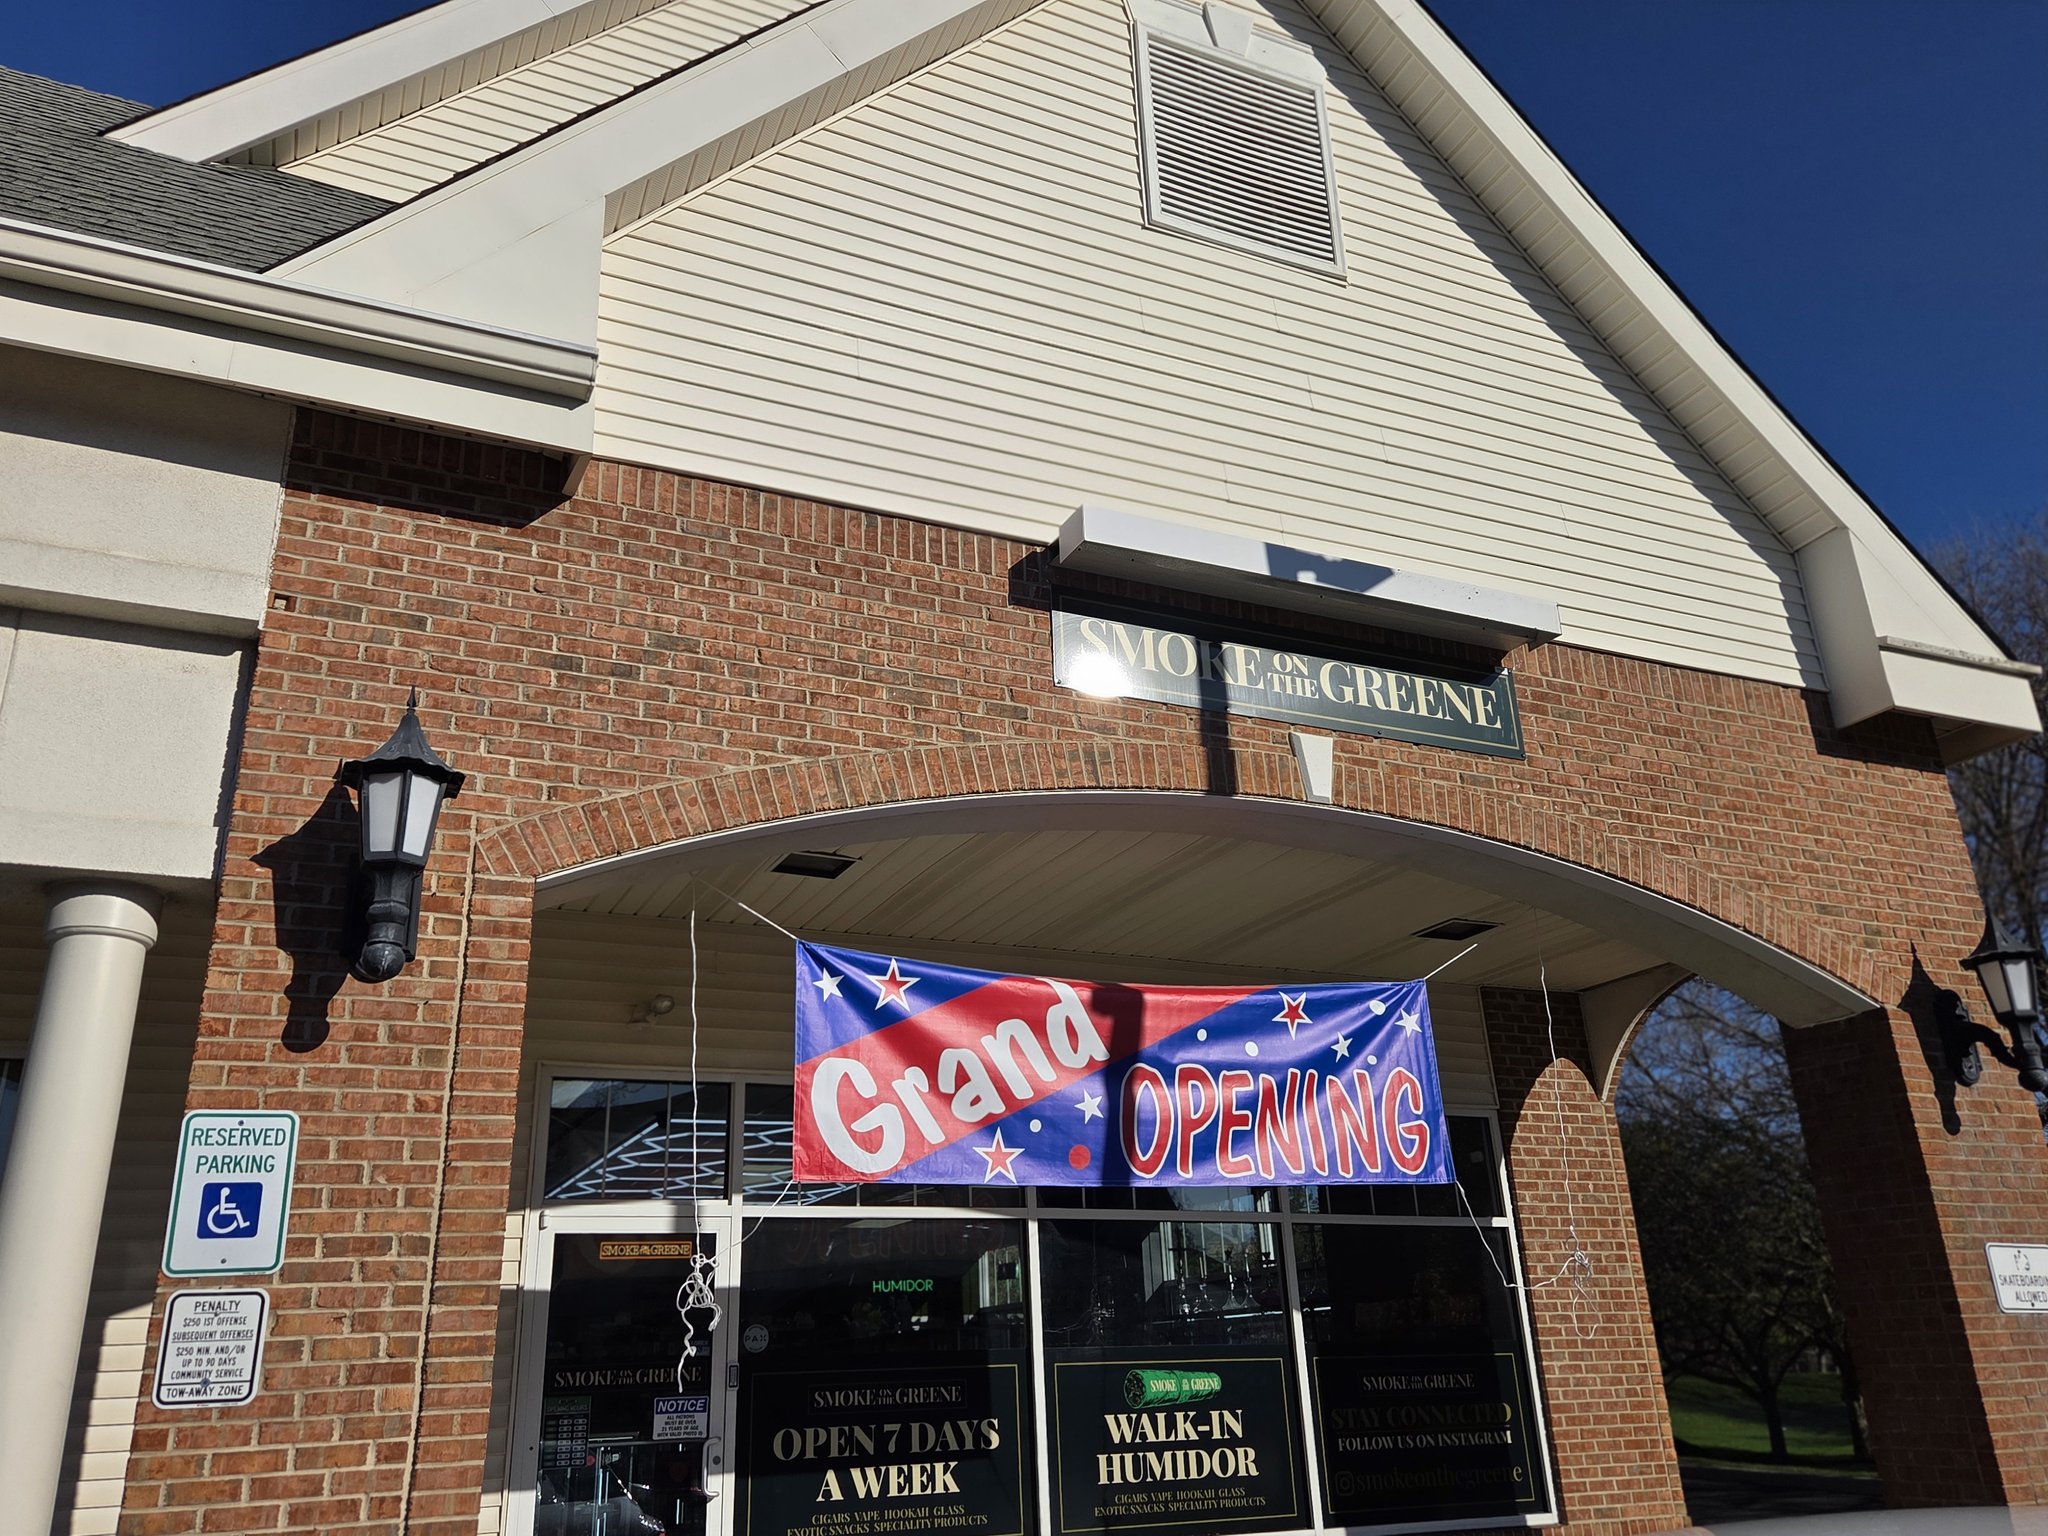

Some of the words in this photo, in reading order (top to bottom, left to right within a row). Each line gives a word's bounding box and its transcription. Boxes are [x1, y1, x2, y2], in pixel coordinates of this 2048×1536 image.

[1079, 616, 1265, 690] SMOKE
[1273, 652, 1310, 677] ON
[1267, 671, 1319, 700] THE
[1319, 659, 1502, 730] GREENE
[810, 977, 1110, 1175] Grand
[1118, 1063, 1432, 1179] OPENING
[191, 1127, 287, 1147] RESERVED
[195, 1154, 276, 1174] PARKING
[602, 1244, 640, 1256] SMOKE
[650, 1244, 690, 1255] GREENE
[872, 1279, 934, 1293] HUMIDOR
[194, 1300, 241, 1312] PENALTY
[2015, 1290, 2048, 1303] ALLOWED
[183, 1317, 201, 1328] $250
[216, 1316, 247, 1326] OFFENSE
[172, 1330, 217, 1341] SUBSEQUENT
[220, 1329, 254, 1339] OFFENSES
[176, 1346, 194, 1357] $250
[215, 1344, 246, 1357] AND/OR
[181, 1358, 192, 1368] UP
[194, 1358, 203, 1367] TO
[206, 1358, 215, 1367] 90
[218, 1357, 237, 1366] DAYS
[170, 1370, 213, 1380] COMMUNITY
[215, 1368, 244, 1378] SERVICE
[554, 1369, 617, 1388] SMOKE
[1362, 1375, 1410, 1391] SMOKE
[1424, 1373, 1476, 1389] GREENE
[166, 1386, 215, 1398] TOW-AWAY
[218, 1385, 244, 1396] ZONE
[1150, 1379, 1178, 1392] SMOKE
[1190, 1378, 1220, 1390] GREENE
[657, 1399, 706, 1413] NOTICE
[814, 1389, 876, 1408] SMOKE
[895, 1385, 962, 1404] GREENE
[1331, 1405, 1383, 1430] STAY
[1386, 1402, 1513, 1427] CONNECTED
[1104, 1409, 1244, 1444] WALK-IN
[772, 1425, 877, 1461] OPEN
[882, 1423, 902, 1454] 7
[910, 1417, 1001, 1454] DAYS
[1338, 1435, 1396, 1452] FOLLOW
[1397, 1434, 1414, 1449] US
[1416, 1433, 1435, 1448] ON
[1438, 1429, 1513, 1447] INSTAGRAM
[1096, 1447, 1260, 1485] HUMIDOR
[815, 1468, 844, 1502] A
[849, 1461, 961, 1499] WEEK
[1114, 1493, 1149, 1505] CIGARS
[1150, 1490, 1174, 1503] VAPE
[1176, 1489, 1215, 1501] HOOKAH
[1218, 1487, 1246, 1498] GLASS
[811, 1512, 851, 1525] CIGARS
[854, 1510, 880, 1523] VAPE
[884, 1506, 929, 1520] HOOKAH
[933, 1505, 965, 1517] GLASS
[1094, 1505, 1130, 1517] EXOTIC
[1130, 1502, 1165, 1515] SNACKS
[1168, 1499, 1219, 1513] SPECIALITY
[1219, 1496, 1267, 1510] PRODUCTS
[829, 1523, 870, 1536] SNACKS
[874, 1518, 933, 1533] SPECIALITY
[933, 1514, 988, 1529] PRODUCTS
